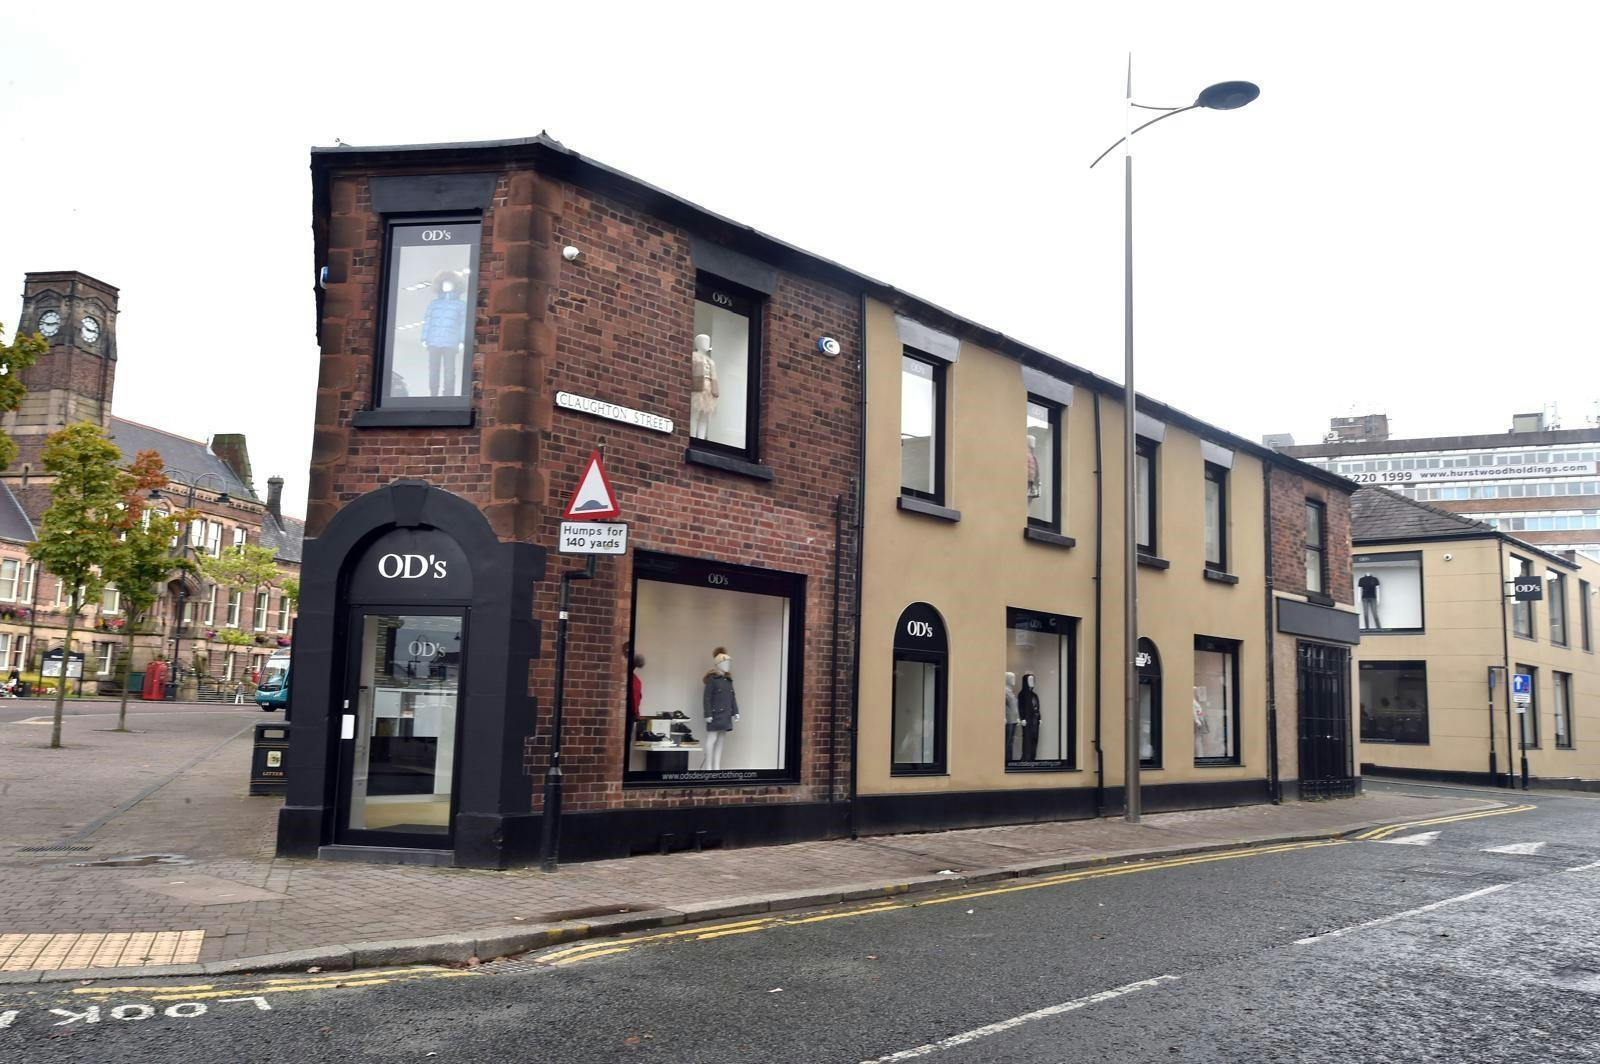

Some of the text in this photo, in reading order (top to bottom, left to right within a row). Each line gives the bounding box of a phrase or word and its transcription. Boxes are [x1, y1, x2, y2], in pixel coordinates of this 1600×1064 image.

[422, 230, 451, 241] OD's
[560, 393, 671, 431] CLAUGHTON STREET
[1353, 473, 1377, 483] 220
[1382, 471, 1412, 482] 1999
[1420, 464, 1588, 479] www.hurstwoodholdings.com
[563, 525, 623, 537] Humps for
[566, 537, 620, 549] 140 yards
[378, 553, 447, 579] OD's
[708, 573, 729, 585] OD's
[1515, 583, 1541, 593] OD's
[907, 620, 933, 638] OD's
[408, 640, 447, 658] OD's
[662, 771, 758, 781] www.odsdesignerclothing.com
[49, 997, 272, 1026] LOOK
